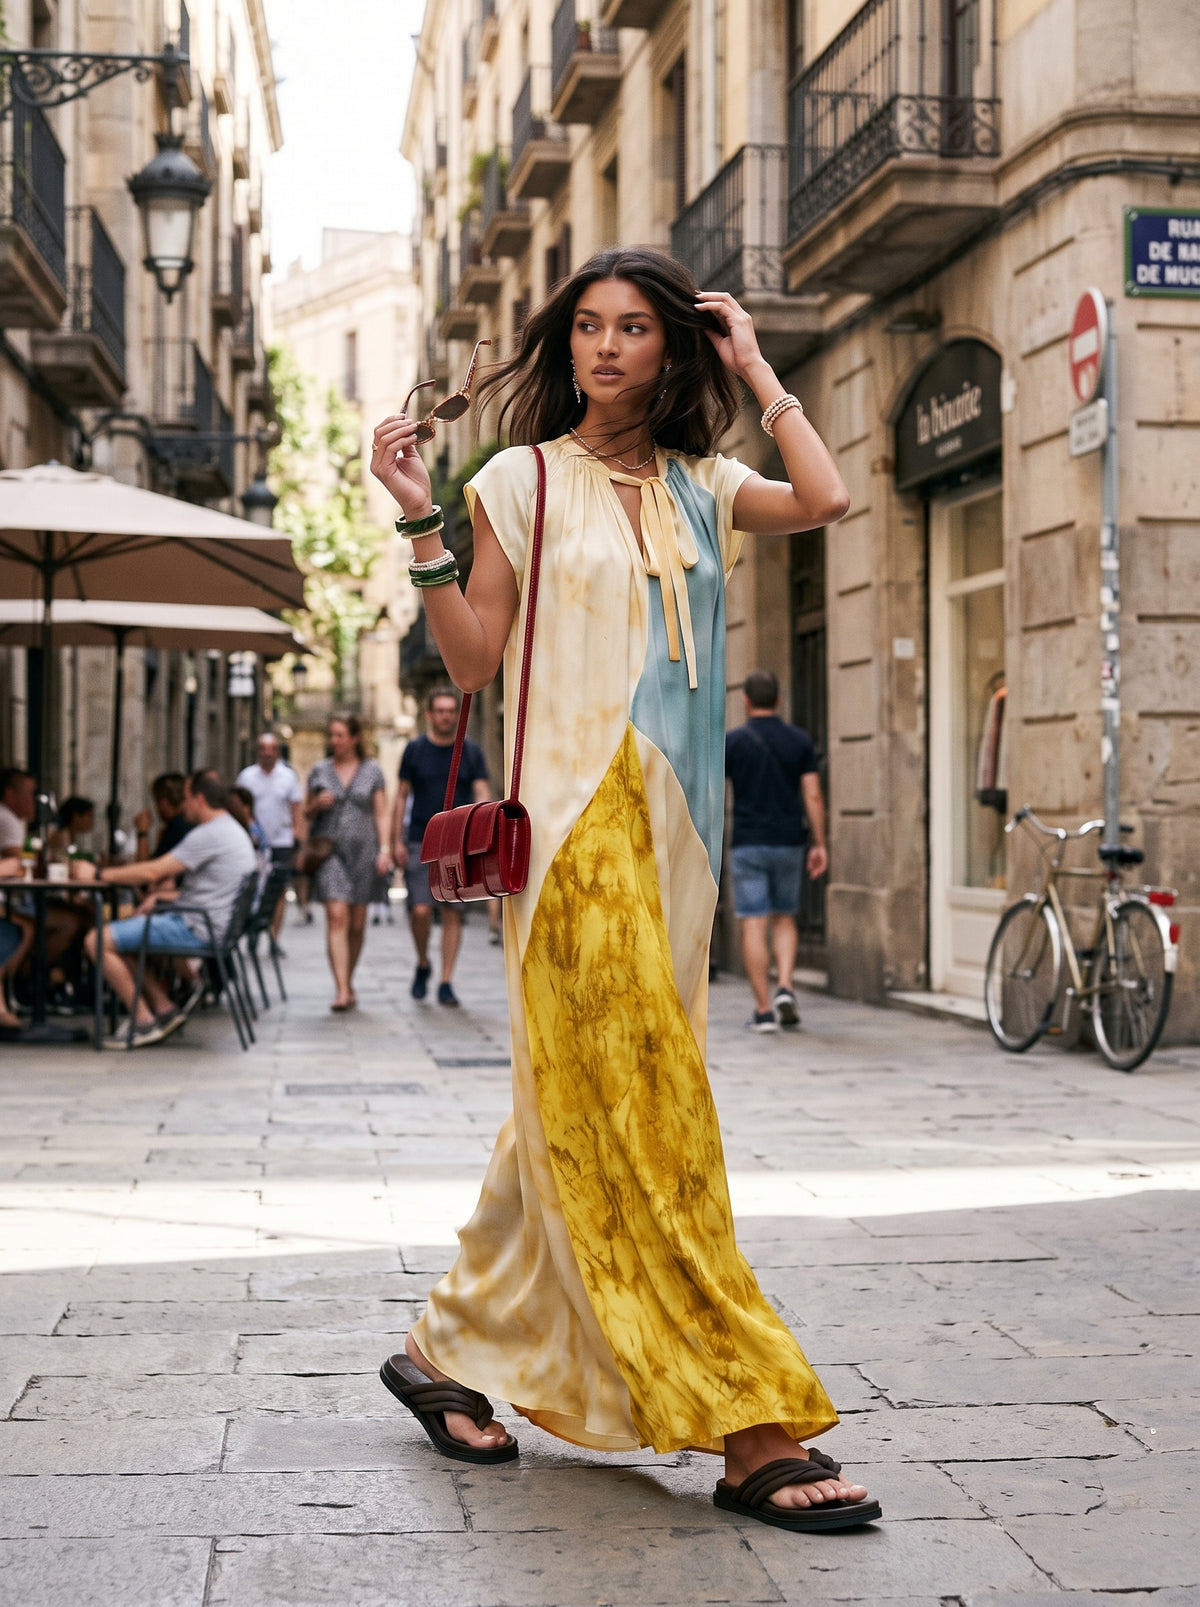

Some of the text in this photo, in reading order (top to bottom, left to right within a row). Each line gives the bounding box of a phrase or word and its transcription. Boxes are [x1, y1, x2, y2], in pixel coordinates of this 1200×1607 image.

[1148, 241, 1200, 262] DE NA
[1137, 264, 1161, 285] DE
